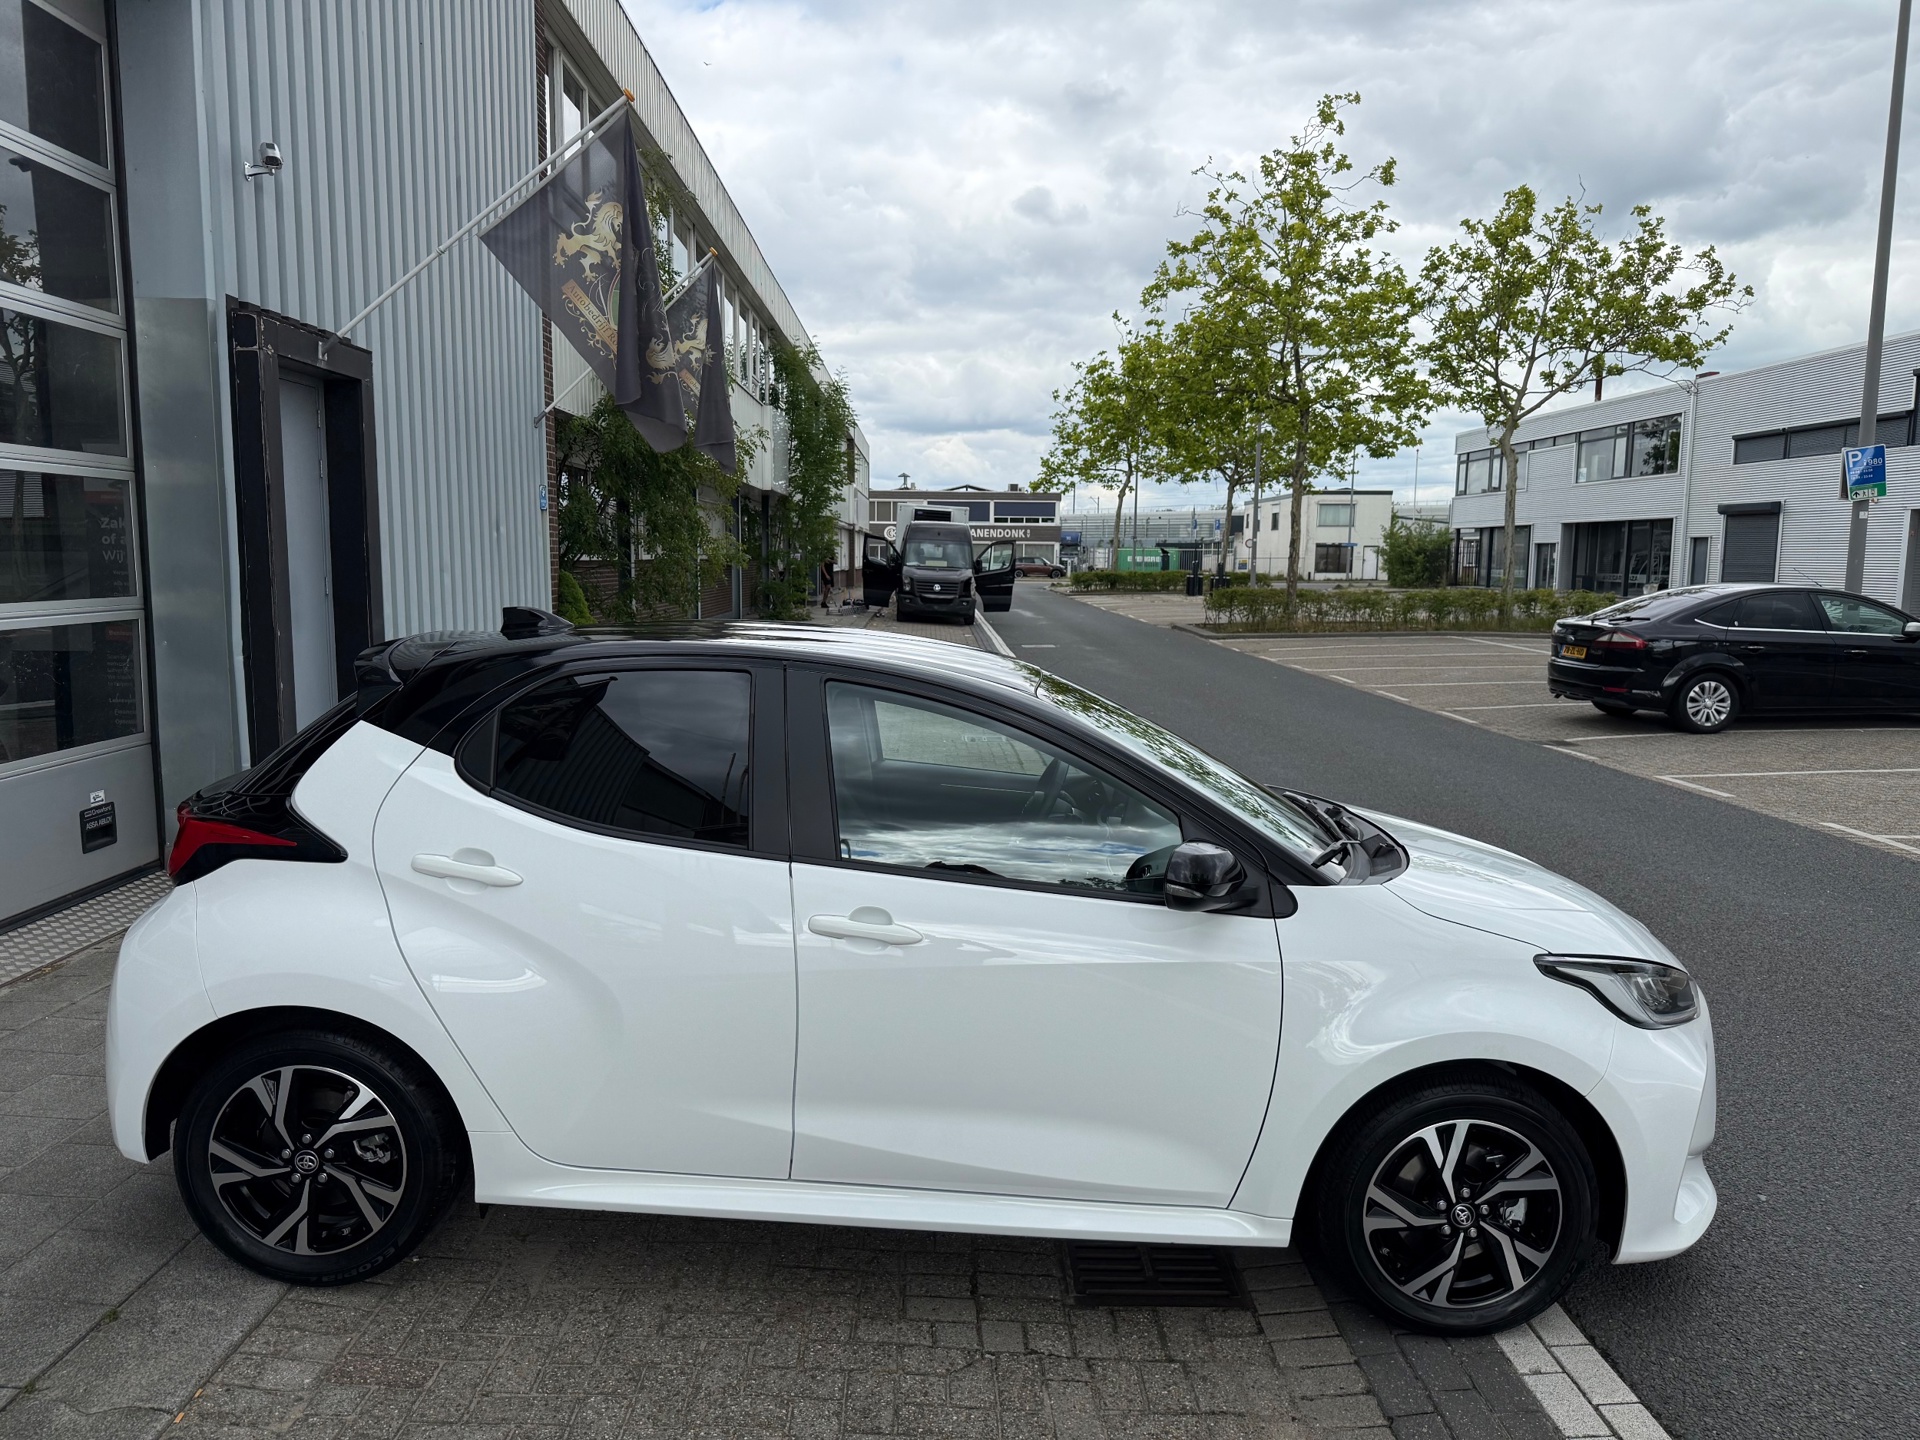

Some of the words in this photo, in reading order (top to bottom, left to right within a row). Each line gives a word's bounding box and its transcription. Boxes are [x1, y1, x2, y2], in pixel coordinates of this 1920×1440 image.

[567, 285, 611, 334] Autobedrijf
[1848, 450, 1862, 468] P
[86, 820, 98, 831] ASSA
[98, 815, 113, 827] ABLOY
